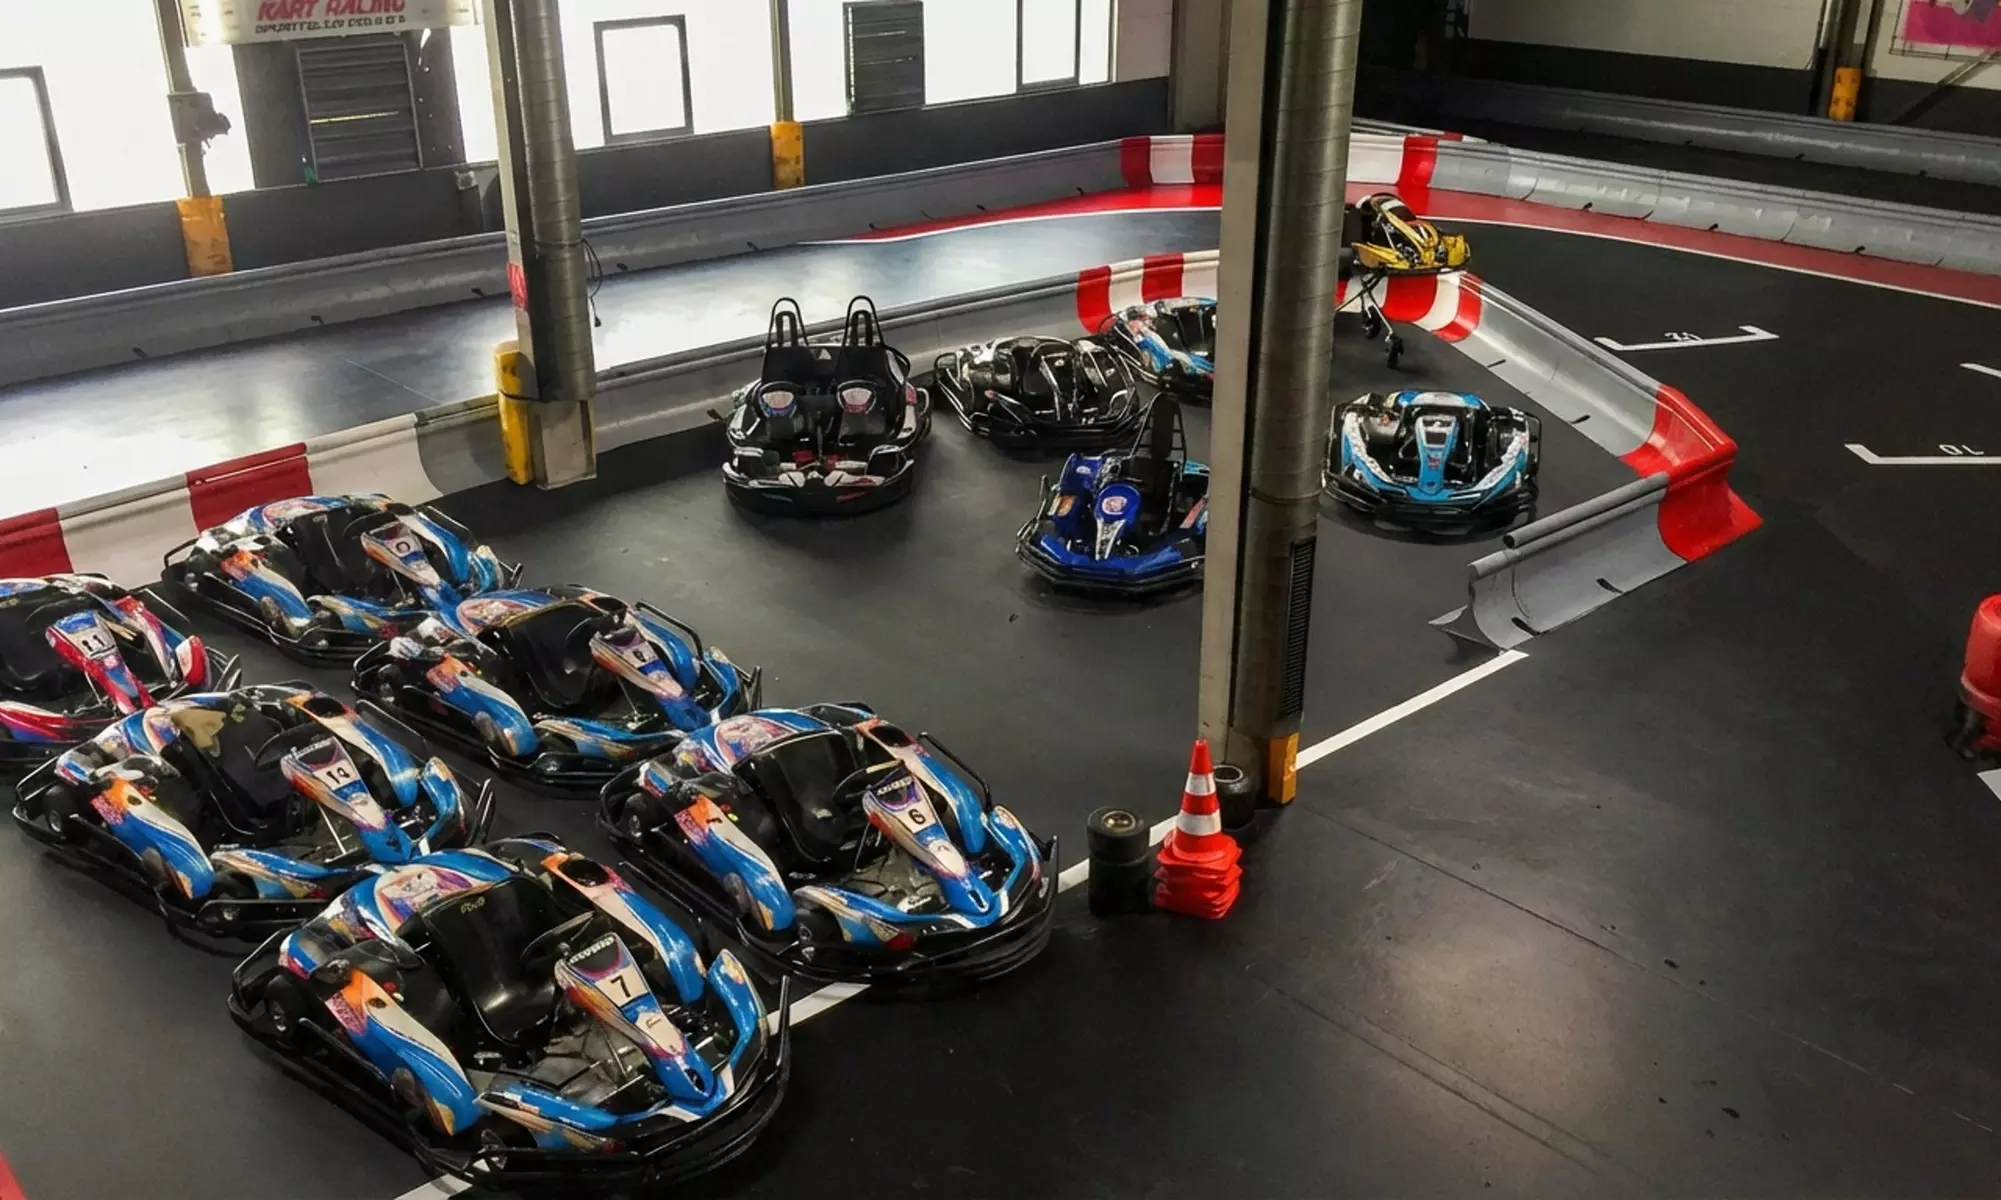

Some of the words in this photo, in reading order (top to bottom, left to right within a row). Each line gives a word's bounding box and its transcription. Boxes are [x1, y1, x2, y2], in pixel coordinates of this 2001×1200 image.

[257, 0, 319, 21] KART
[908, 808, 926, 825] 6
[610, 974, 632, 998] 7
